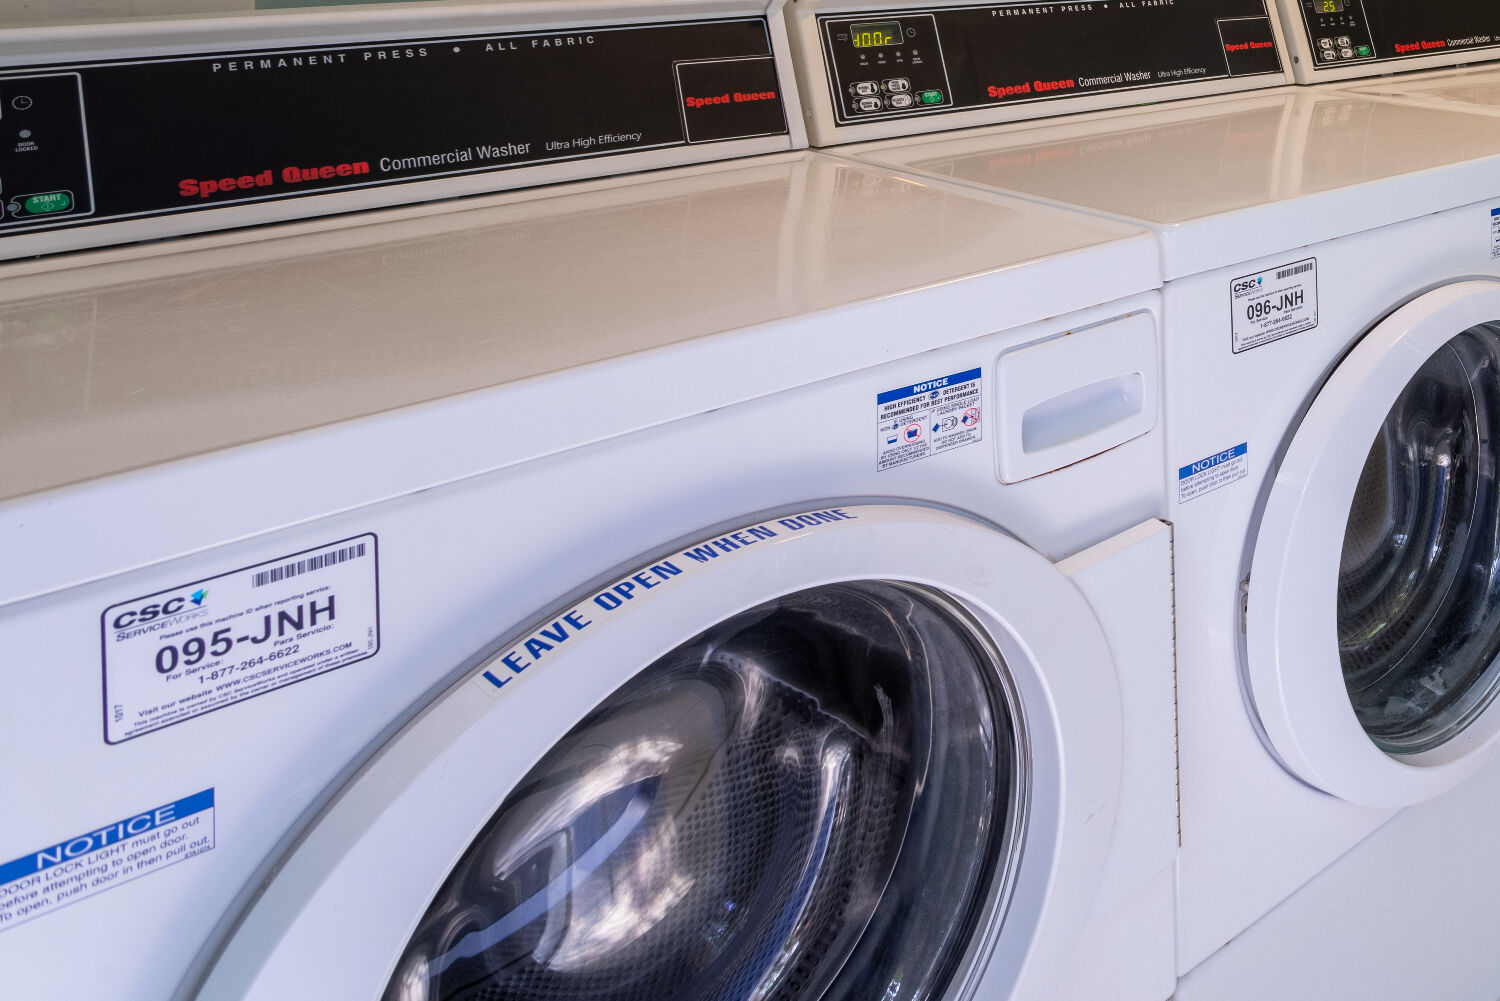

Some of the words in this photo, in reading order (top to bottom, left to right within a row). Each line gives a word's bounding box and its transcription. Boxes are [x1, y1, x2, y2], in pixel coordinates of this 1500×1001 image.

[992, 6, 1053, 17] PERMANENT
[1061, 4, 1092, 12] PRESS
[1141, 0, 1174, 7] FABRIC
[1322, 0, 1335, 13] 25
[212, 54, 346, 72] PERMANENT
[364, 48, 427, 61] PRESS
[485, 42, 517, 52] ALL
[531, 36, 594, 48] FABRIC
[1225, 42, 1249, 52] Speed
[1249, 41, 1273, 49] Queen
[1394, 40, 1420, 54] Speed
[1421, 39, 1446, 50] Queen
[987, 83, 1030, 97] Speed
[1033, 80, 1075, 92] Queen
[1077, 73, 1123, 87] Commercial
[1124, 71, 1151, 82] Washer
[684, 94, 730, 109] Speed
[733, 90, 775, 104] Queen
[179, 170, 273, 197] Speed
[281, 161, 370, 183] Queen
[379, 148, 472, 172] Commercial
[476, 143, 531, 159] Washer
[545, 141, 570, 151] Ultra
[572, 136, 596, 149] High
[598, 132, 642, 144] Efficiency
[32, 193, 61, 204] START
[1233, 280, 1256, 292] CSC
[1247, 289, 1303, 320] 096-JNH
[913, 378, 949, 394] NOTICE
[1192, 448, 1235, 473] NOTICE
[482, 609, 592, 689] LEAVE
[592, 561, 684, 611] OPEN
[684, 525, 779, 563] WHEN
[777, 508, 858, 531] DONE
[113, 597, 185, 629] CSC
[155, 595, 335, 674] 095-JNH
[274, 637, 294, 647] Para
[296, 624, 335, 640] Servicio:
[166, 673, 182, 683] For
[185, 658, 225, 676] Service:
[199, 644, 299, 684] 1-877-264-6622
[138, 707, 158, 717] Visit
[161, 701, 176, 710] our
[179, 690, 213, 704] website
[37, 805, 175, 869] NOTICE
